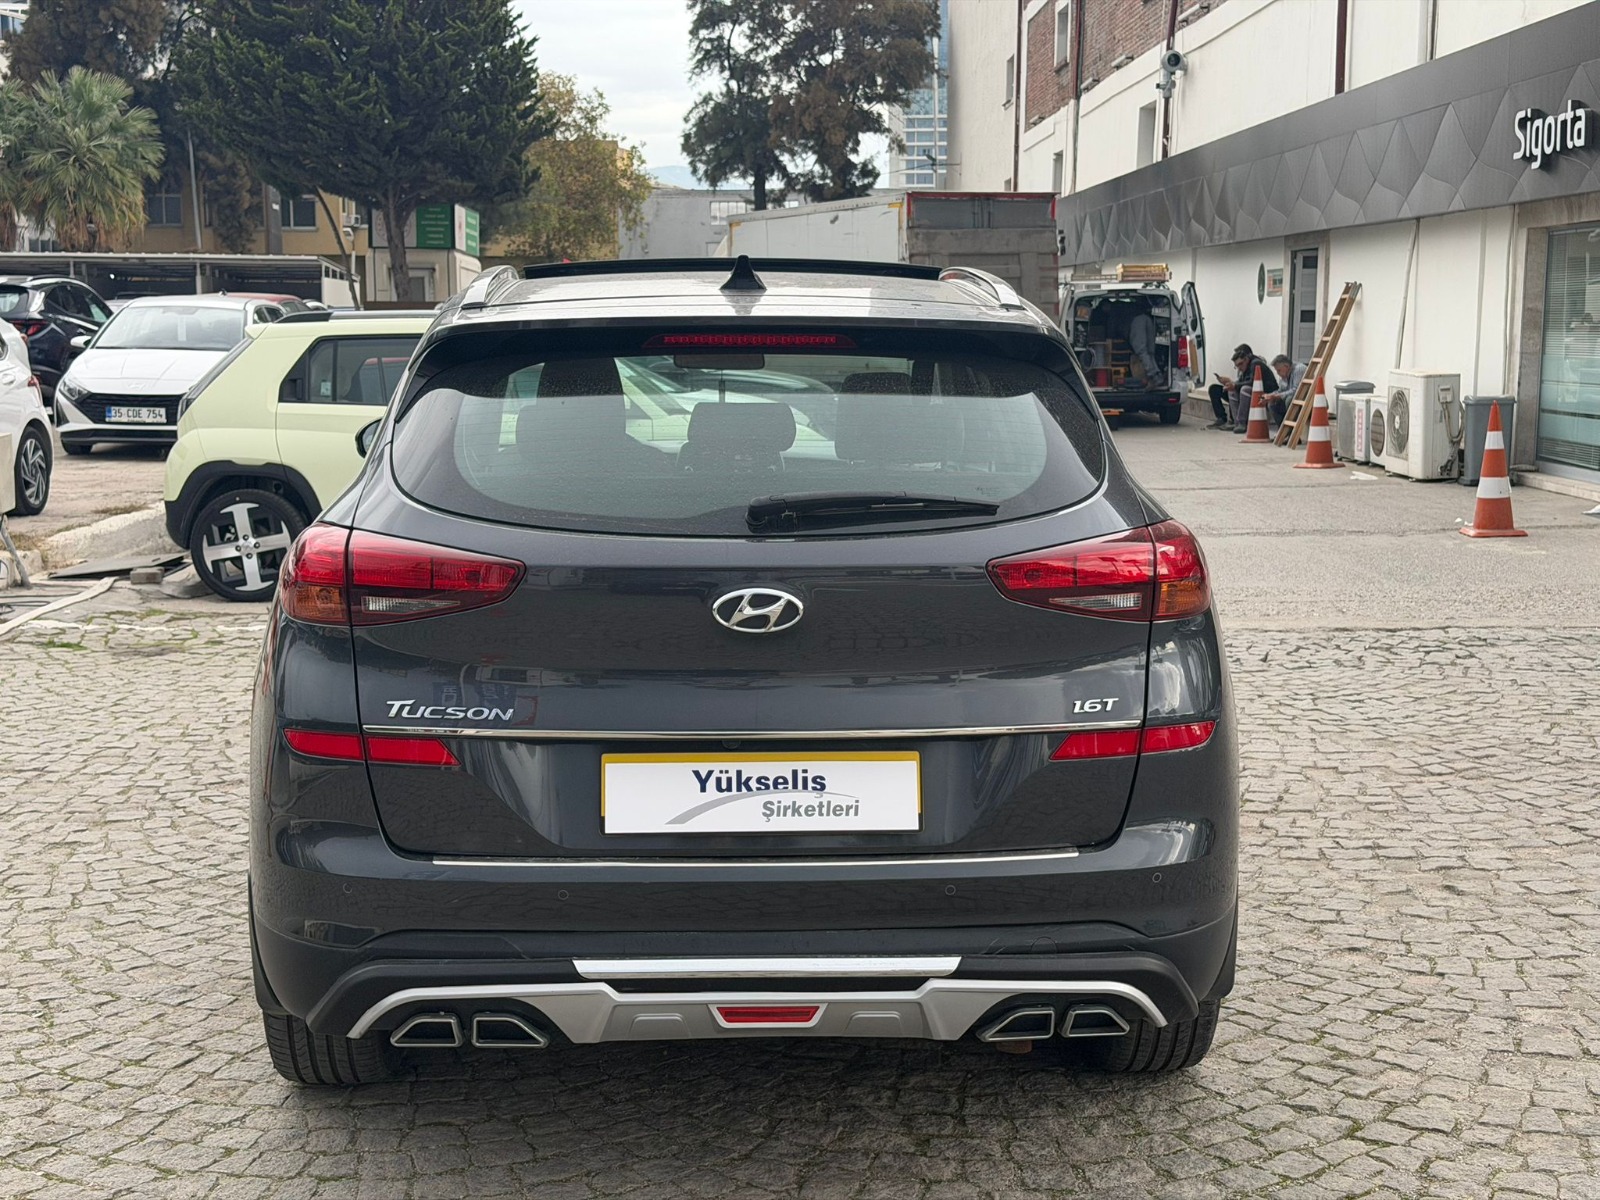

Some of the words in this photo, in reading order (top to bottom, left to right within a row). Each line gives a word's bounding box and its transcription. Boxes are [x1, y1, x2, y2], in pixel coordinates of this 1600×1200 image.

[1513, 99, 1586, 170] Sigorta
[112, 408, 123, 418] 35
[126, 408, 143, 419] CDE
[146, 409, 163, 419] 754
[691, 768, 827, 799] Yükseliş
[761, 799, 860, 823] Şirketleri
